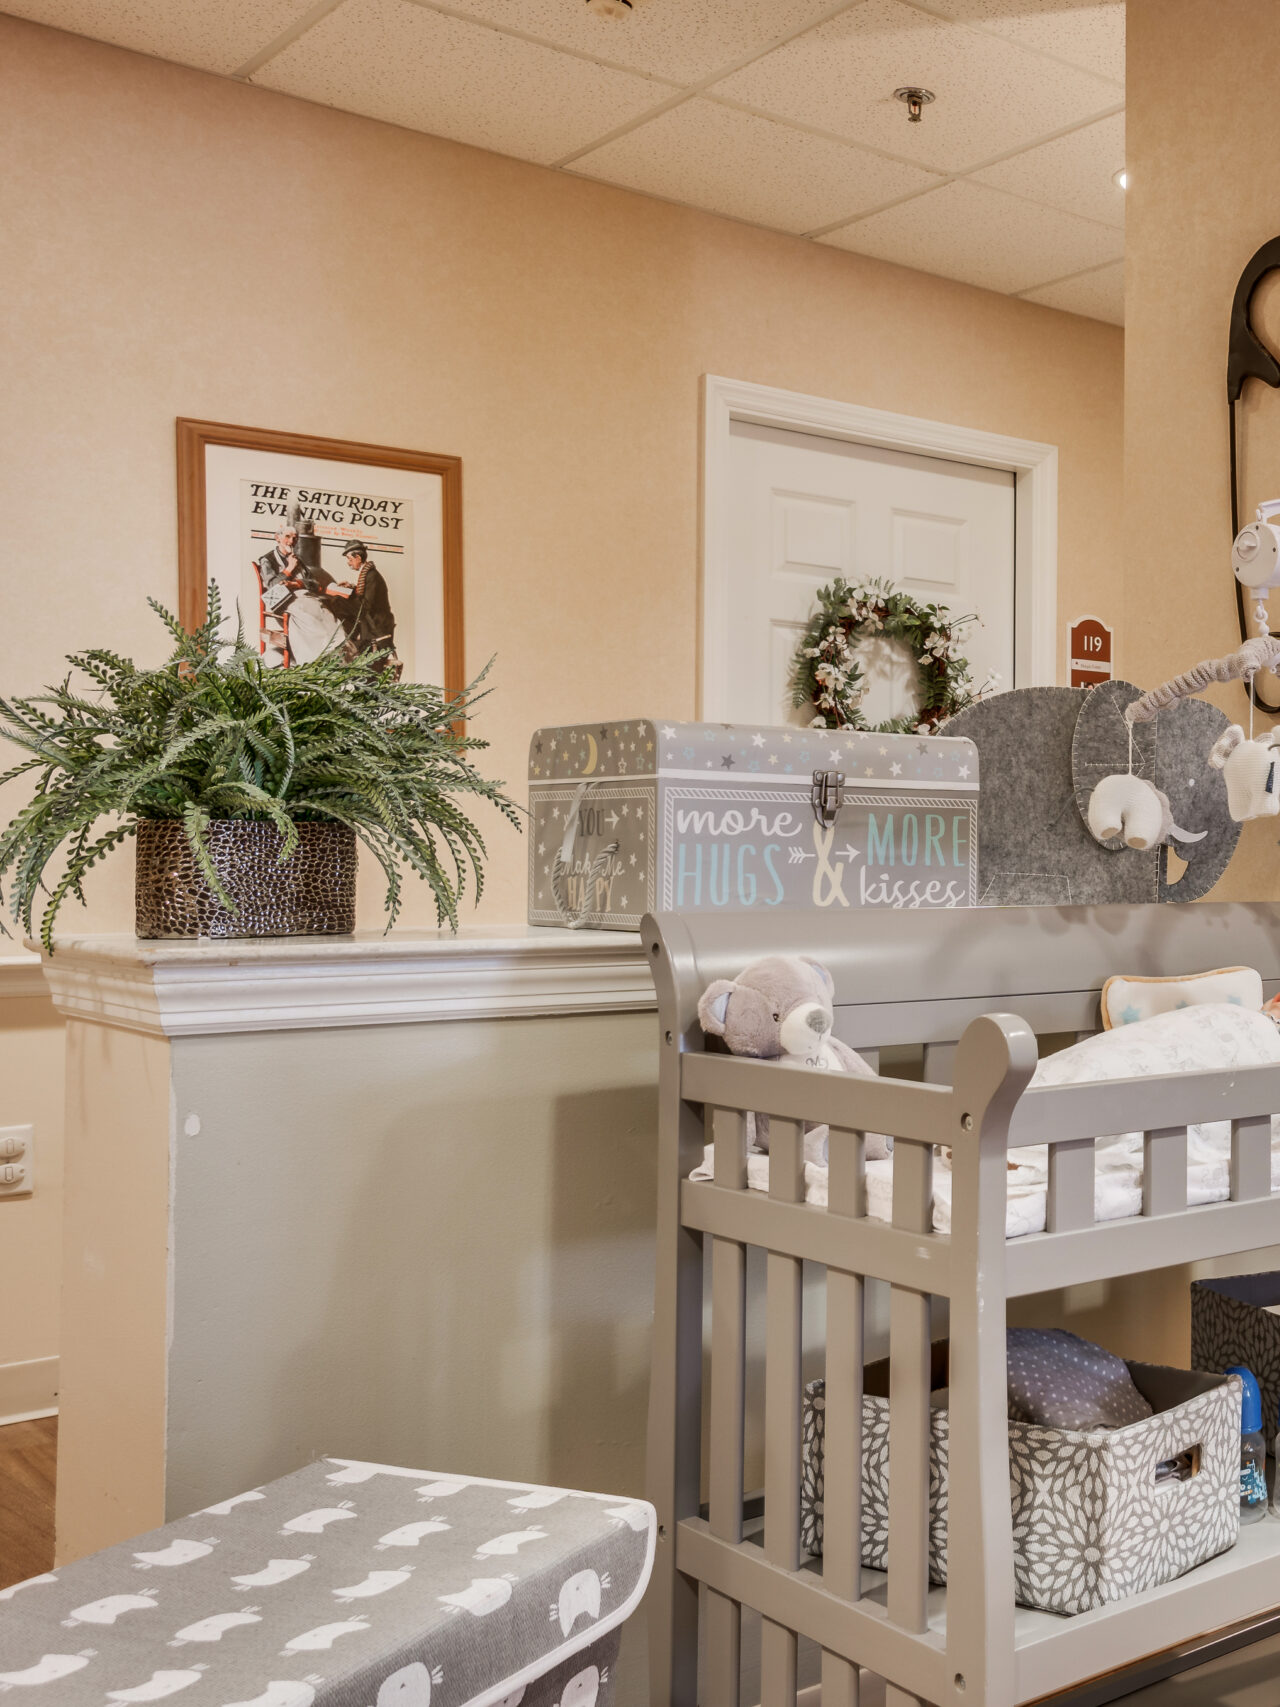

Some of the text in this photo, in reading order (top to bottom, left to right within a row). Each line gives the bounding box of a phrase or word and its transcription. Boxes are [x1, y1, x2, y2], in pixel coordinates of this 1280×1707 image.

[250, 484, 404, 514] THE SATURDAY
[349, 511, 405, 530] POST
[1083, 635, 1103, 652] 119
[578, 807, 605, 837] YOU
[676, 807, 802, 837] more
[560, 852, 593, 876] Mak
[677, 812, 967, 908] HUGS & MORE
[567, 874, 614, 912] HAPY
[860, 864, 966, 909] kisses
